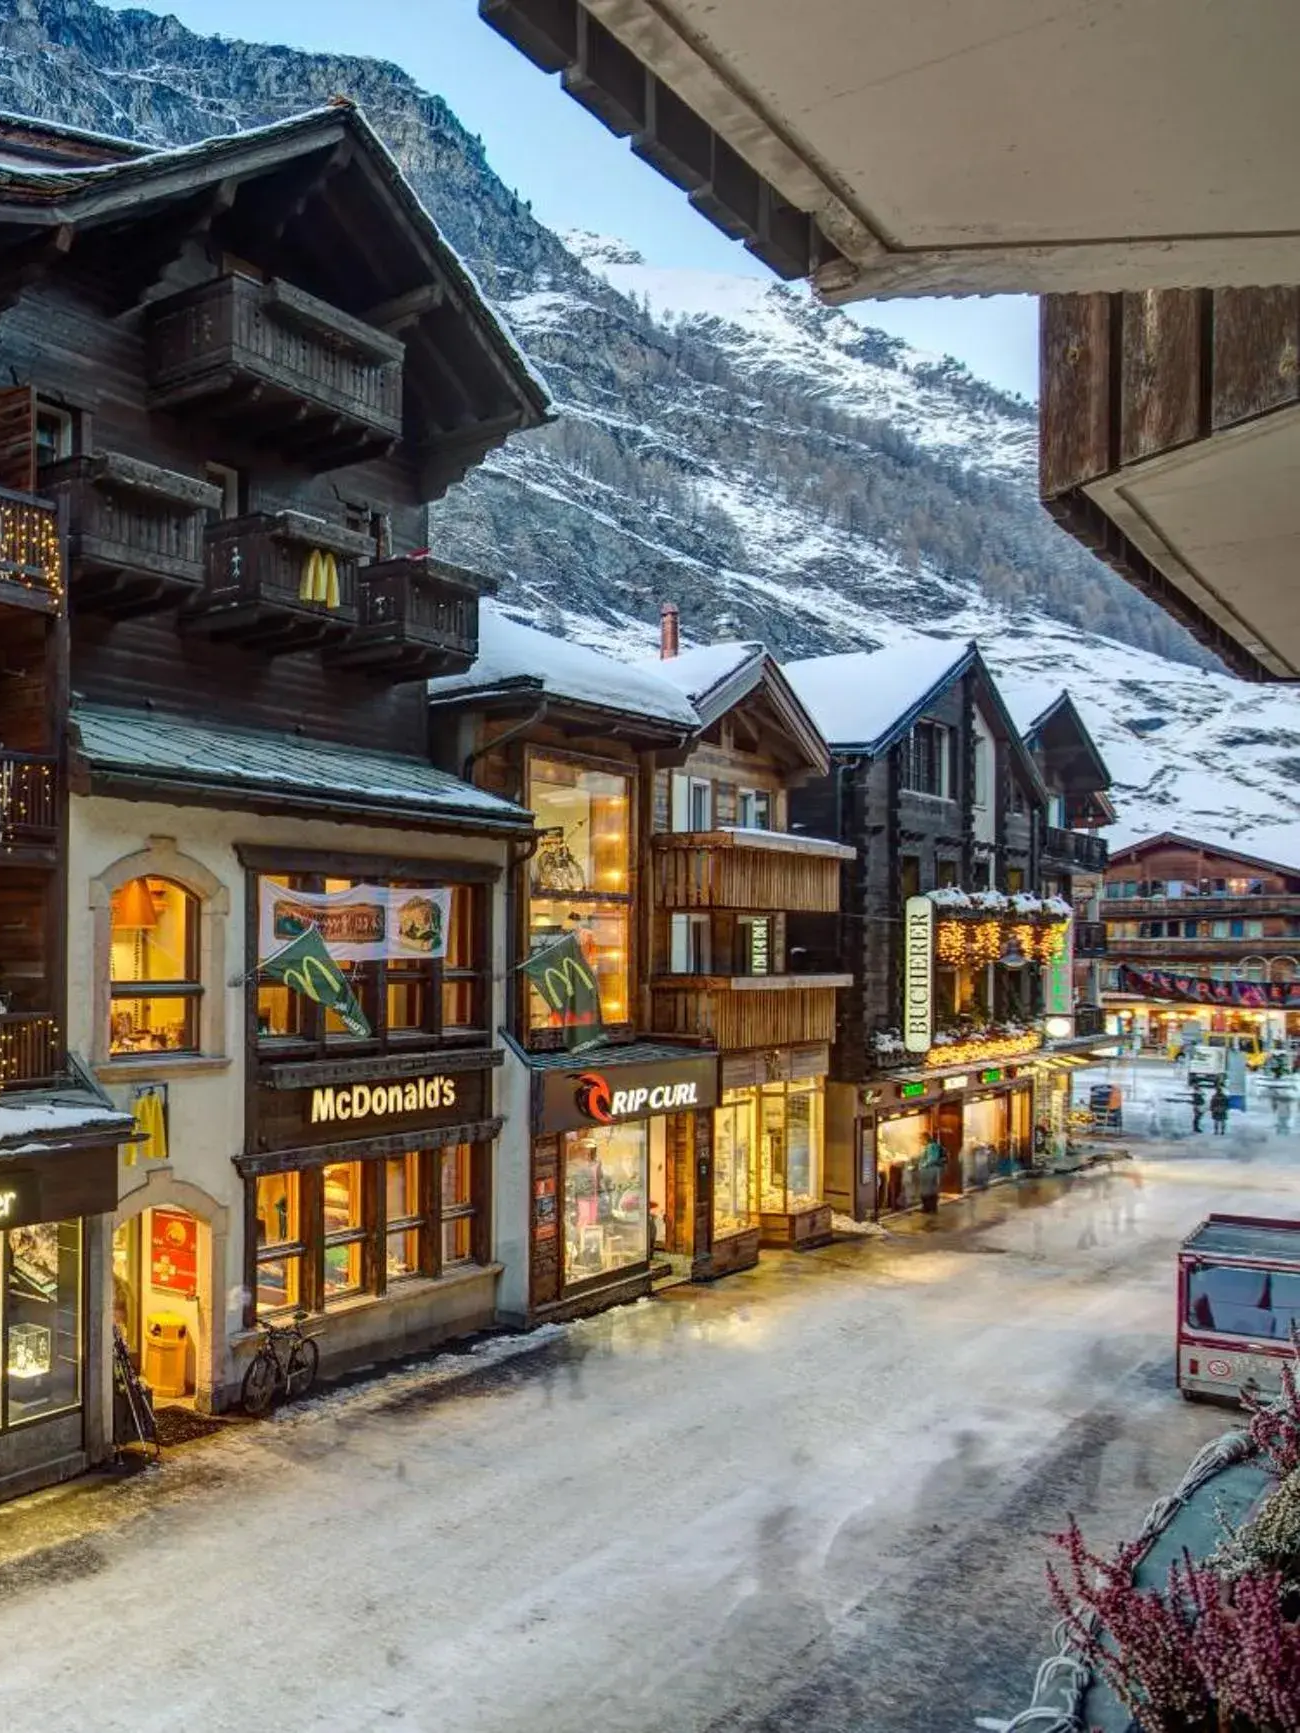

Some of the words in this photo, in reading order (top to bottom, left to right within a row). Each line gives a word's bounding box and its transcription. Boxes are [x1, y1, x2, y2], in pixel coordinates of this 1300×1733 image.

[909, 913, 929, 1036] BUCHERER
[311, 1076, 455, 1122] McDonald's
[611, 1088, 648, 1115] RIP
[648, 1082, 698, 1108] CURL
